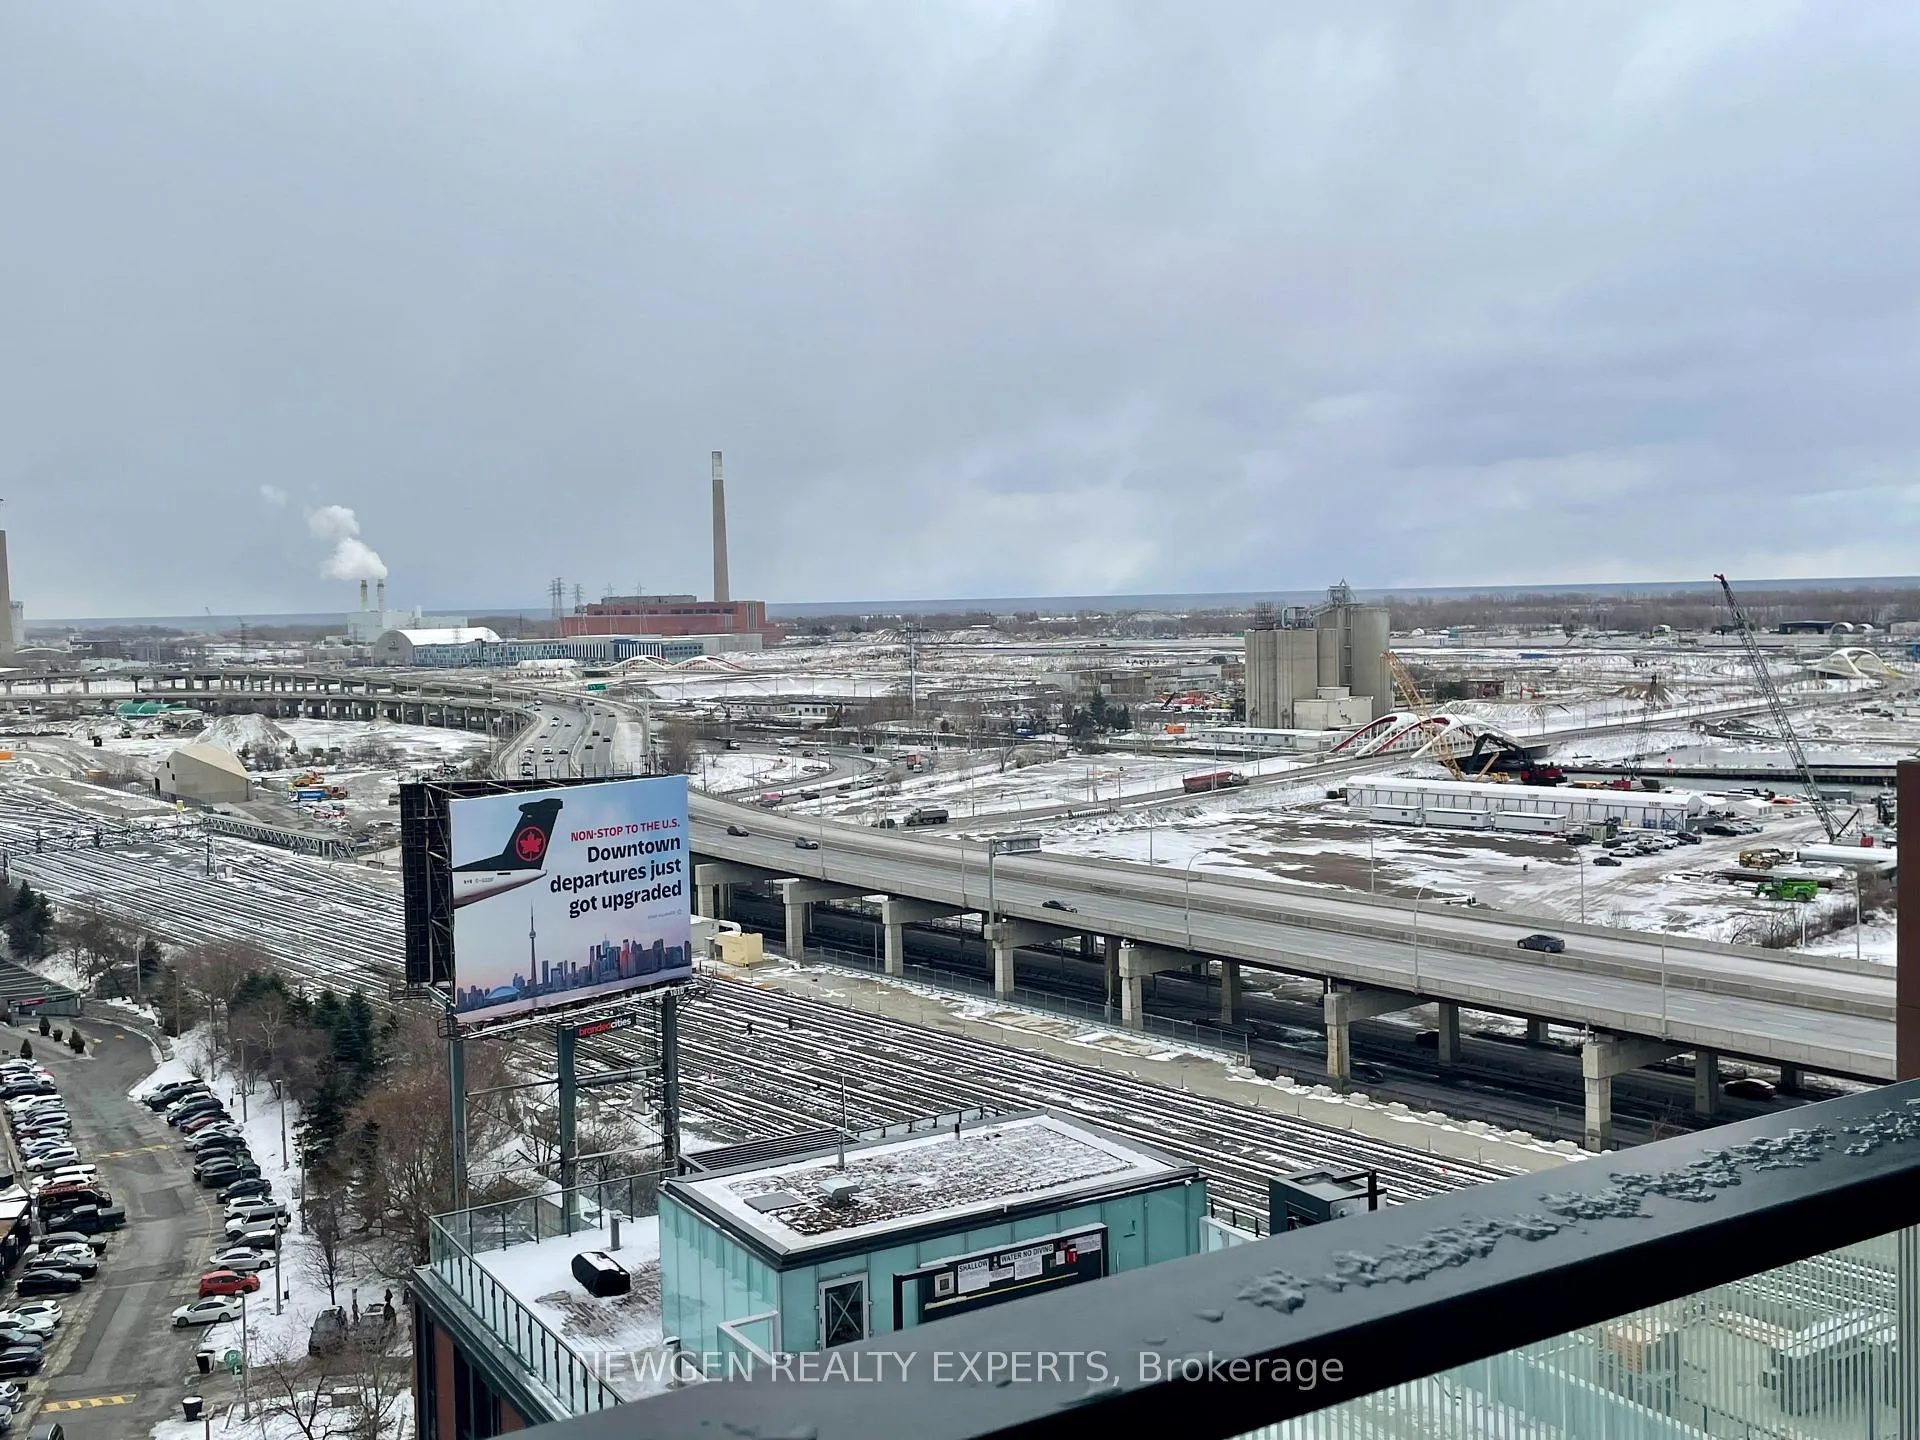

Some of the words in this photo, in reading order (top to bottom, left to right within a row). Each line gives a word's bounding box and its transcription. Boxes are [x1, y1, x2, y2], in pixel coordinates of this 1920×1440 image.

[571, 826, 623, 842] NON-STOP
[625, 824, 638, 834] TO
[640, 820, 660, 832] THE
[662, 818, 680, 829] U.S.
[587, 837, 680, 863] Downtown
[550, 866, 647, 893] departures
[650, 859, 681, 881] just
[569, 896, 597, 918] got
[602, 880, 682, 911] upgraded
[959, 1261, 988, 1272] SHALLOW
[1001, 1252, 1021, 1262] WATER
[1023, 1249, 1032, 1257] NO
[1033, 1244, 1053, 1255] DIVING
